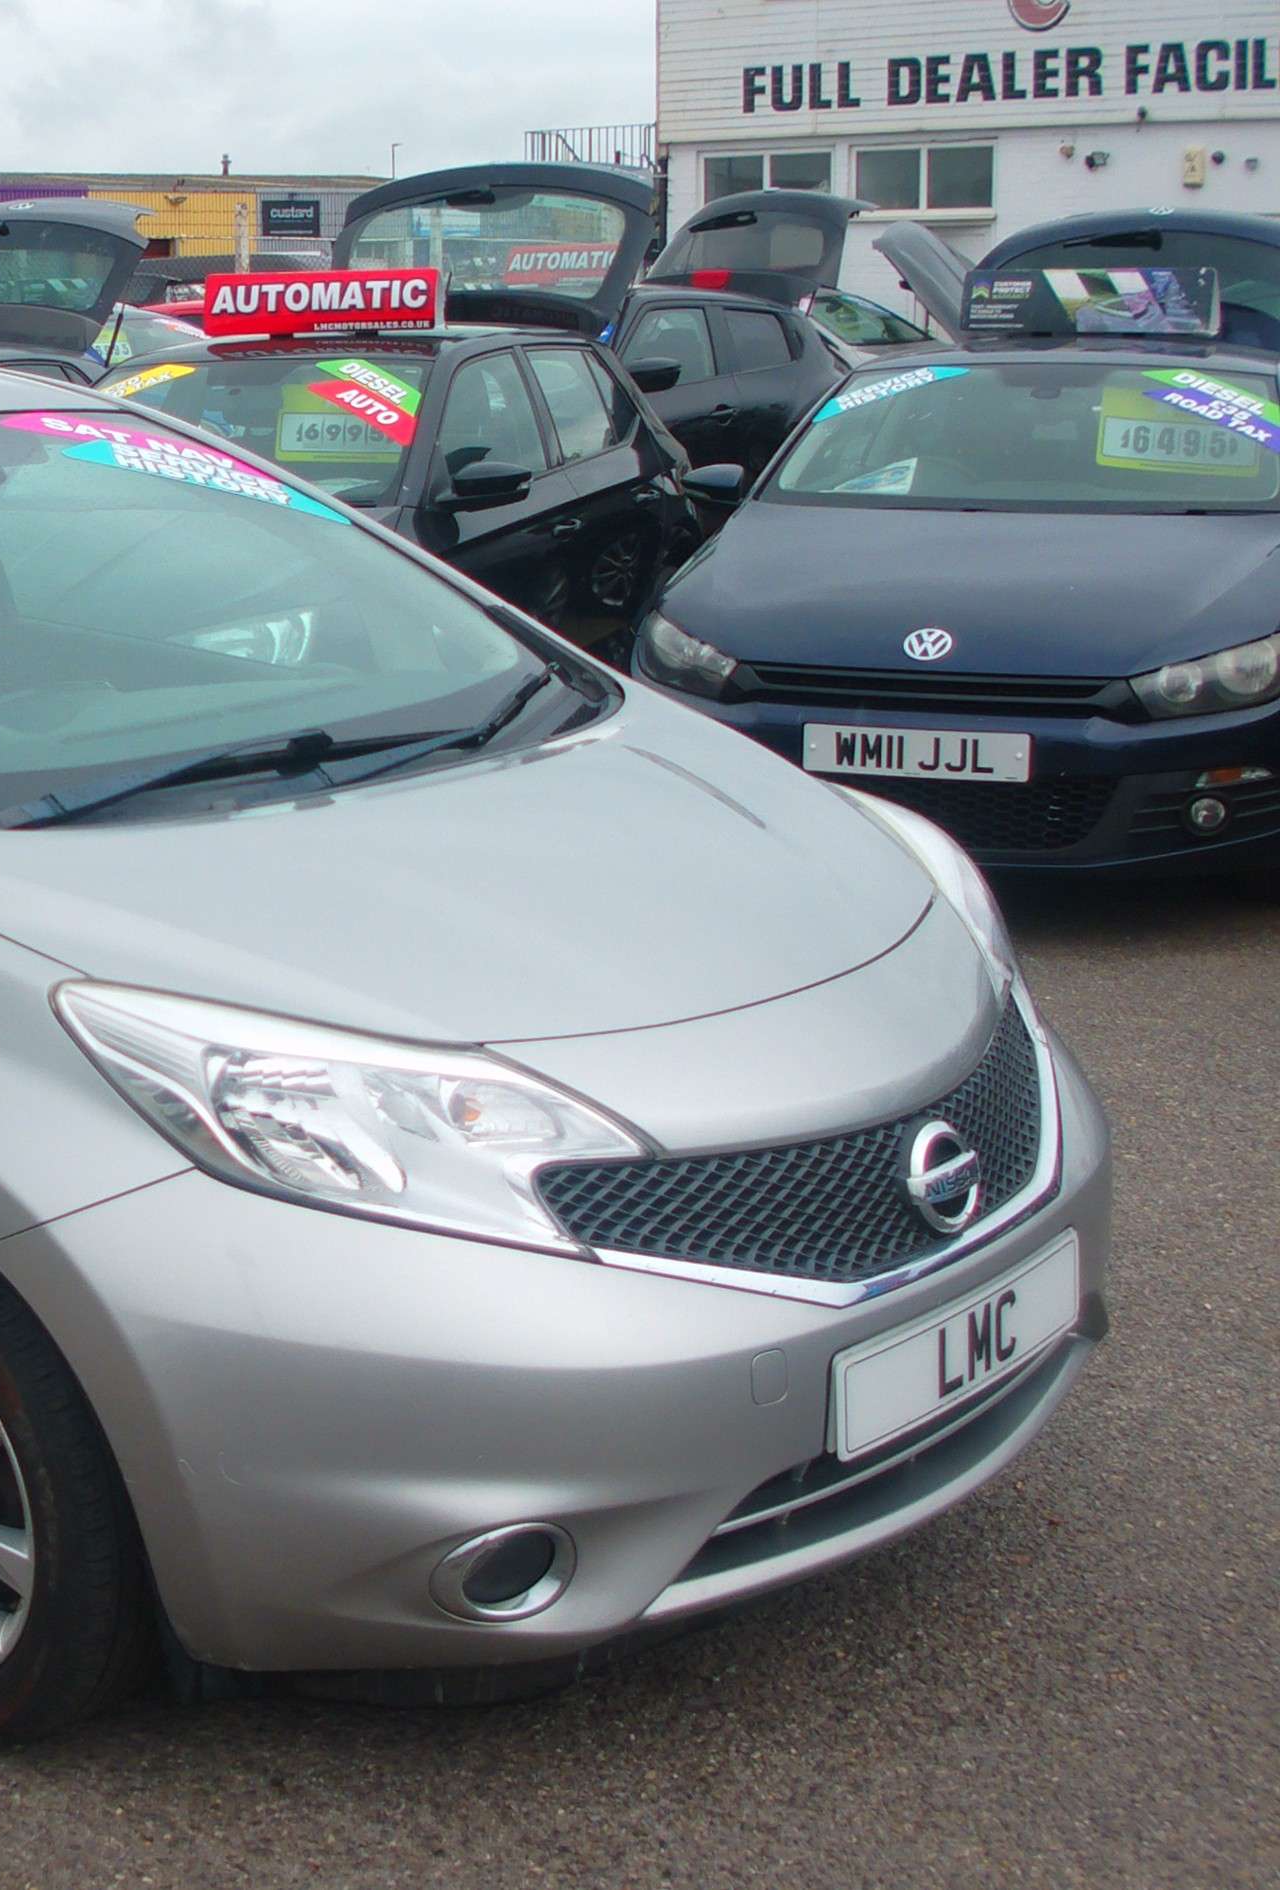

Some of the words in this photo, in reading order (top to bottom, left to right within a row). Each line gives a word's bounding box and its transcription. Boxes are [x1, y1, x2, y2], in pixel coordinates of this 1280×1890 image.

[742, 61, 861, 113] FULL
[886, 46, 1103, 107] DEALER
[270, 206, 314, 218] custard
[211, 279, 428, 315] AUTOMATIC
[313, 320, 430, 332] LMCMOTORSALES.CO.UK
[338, 362, 407, 405] DIESEL
[1172, 372, 1264, 415] DIESEL
[335, 389, 400, 425] AUTO
[1163, 392, 1224, 421] ROAD
[1227, 417, 1273, 443] TAX
[40, 417, 132, 444] SAT
[144, 438, 233, 469] NAV
[111, 443, 284, 491] SERVICE
[115, 454, 292, 505] HISTORY
[835, 732, 904, 769] WM11
[918, 737, 994, 774] JJL
[939, 1289, 1016, 1399] LMC
